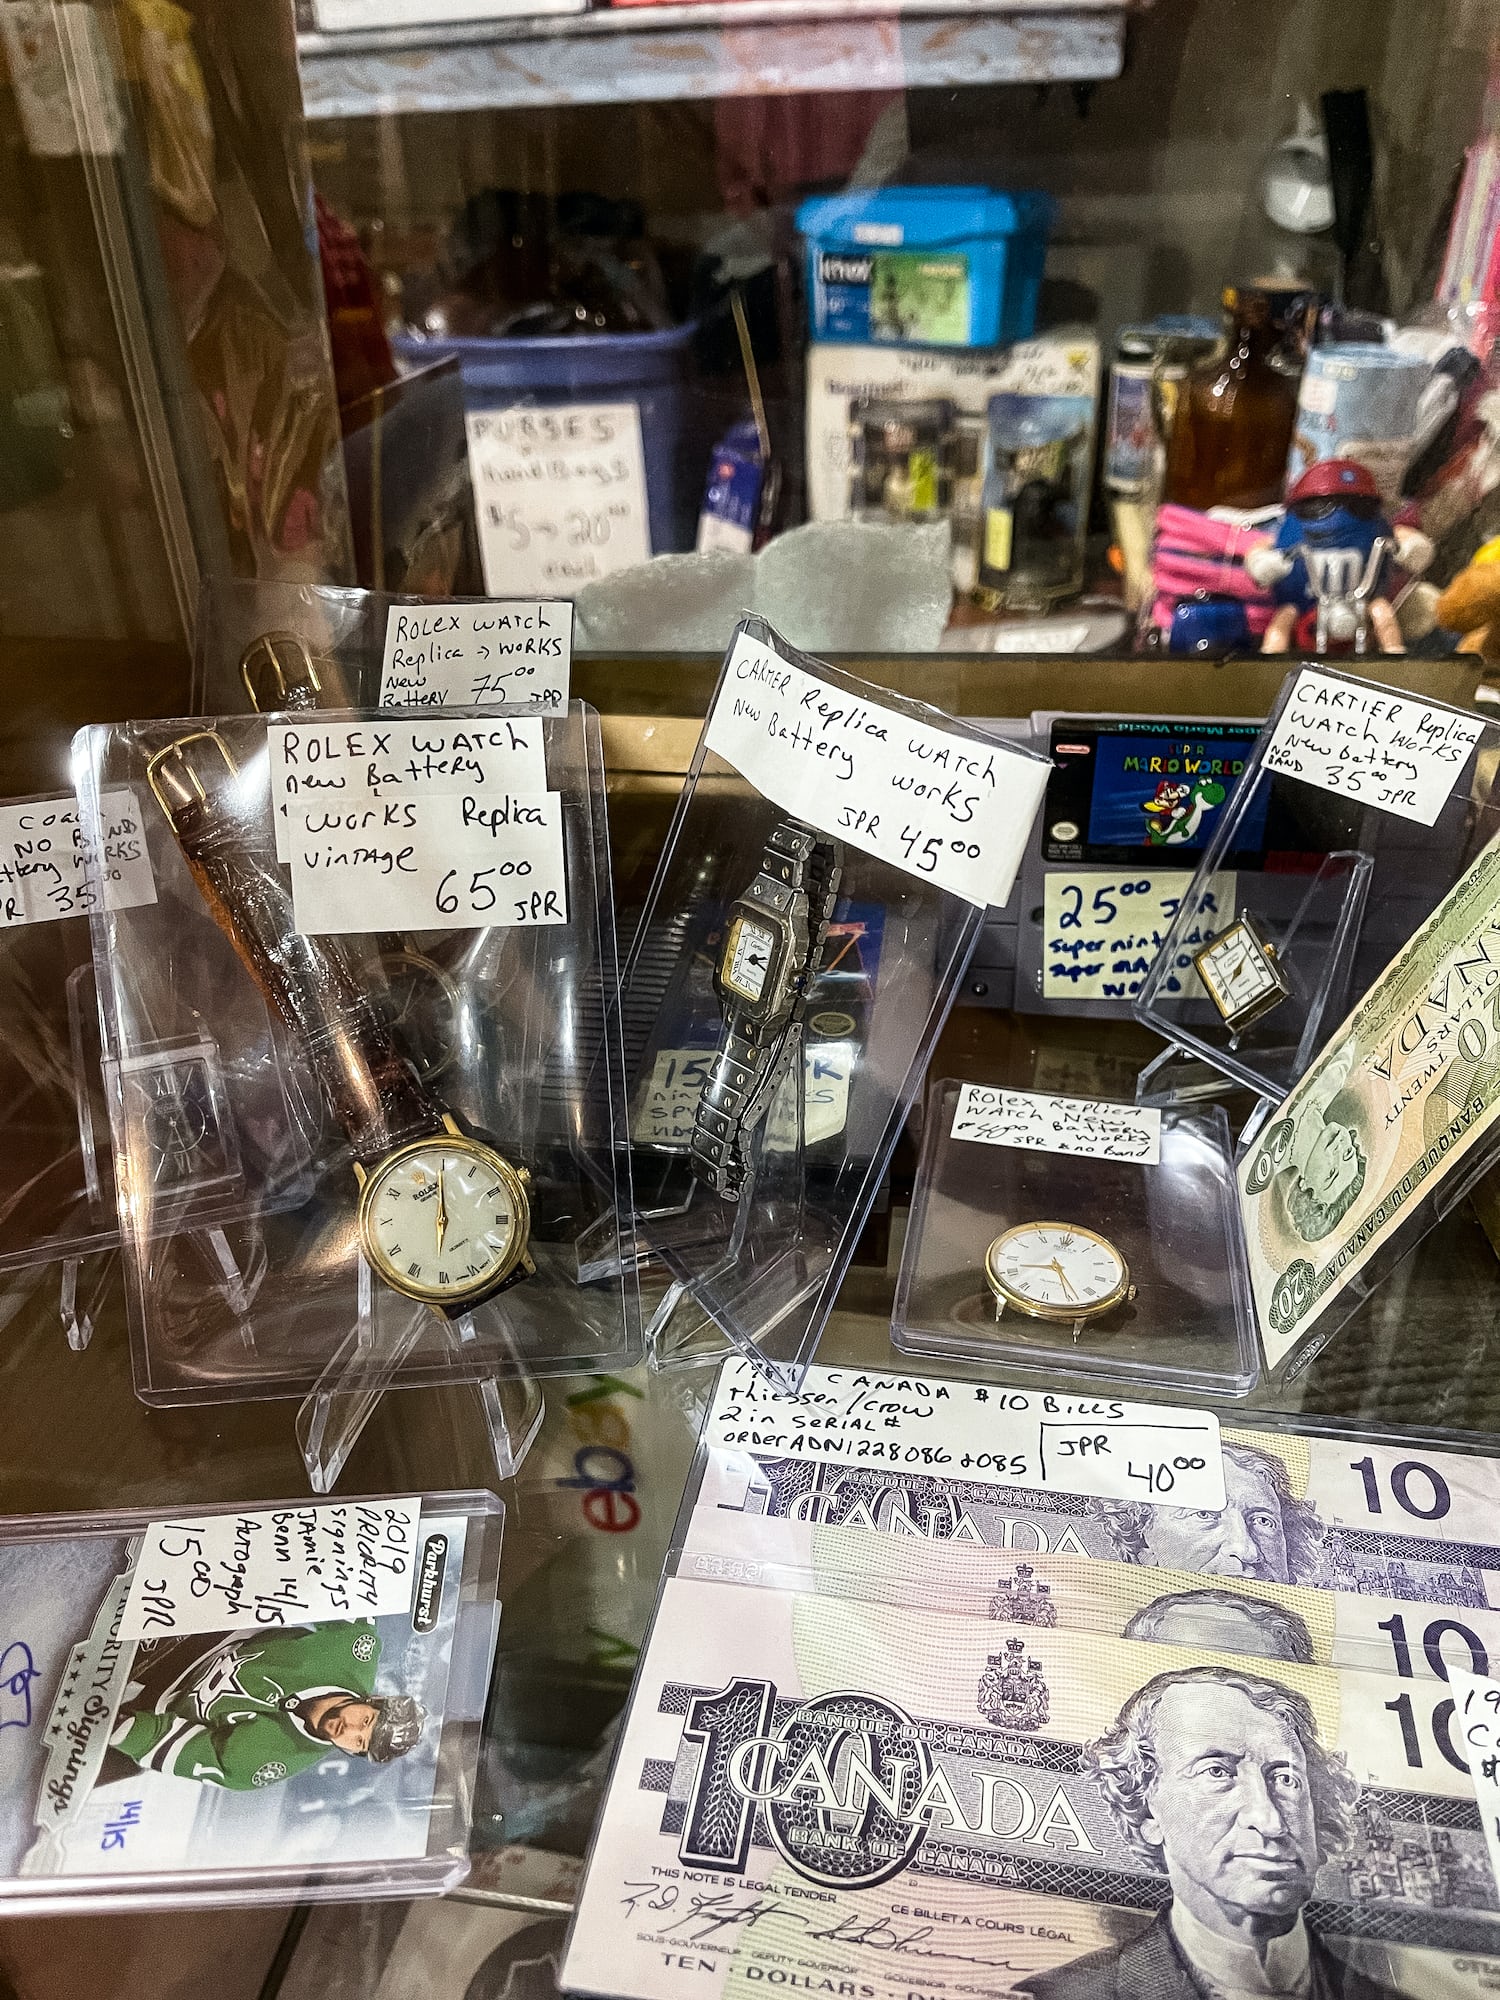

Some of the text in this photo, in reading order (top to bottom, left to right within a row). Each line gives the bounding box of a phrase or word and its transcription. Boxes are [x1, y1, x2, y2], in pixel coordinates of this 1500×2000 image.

[473, 415, 615, 442] PURSES
[392, 642, 464, 669] Replica
[800, 688, 888, 743] Replica
[1297, 684, 1403, 724] CARTIER
[283, 732, 392, 765] ROLEX
[733, 698, 762, 723] New
[769, 712, 855, 780] Battery
[1118, 724, 1170, 734] World
[1124, 757, 1245, 776] MARIO WORLD
[1268, 753, 1304, 773] BAND
[1270, 745, 1290, 758] NO
[1378, 789, 1417, 806] JPR
[462, 797, 547, 838] Replica
[837, 806, 881, 840] JPR
[14, 839, 51, 858] NO
[514, 891, 563, 921] JPR
[1160, 892, 1218, 918] JR
[1378, 1049, 1449, 1134] TWENTY
[1324, 1092, 1488, 1282] BANQUE DU CANADA
[1270, 1272, 1315, 1321] 20
[827, 1373, 950, 1399] CANADA
[719, 1406, 742, 1422] 2
[749, 1409, 775, 1425] in
[1057, 1434, 1112, 1456] JPR
[845, 1471, 1052, 1507] BANQUE DU CANADA
[1350, 1456, 1451, 1521] 10
[378, 1509, 410, 1575] 2019
[255, 1512, 309, 1625] Benn 14/15
[413, 1537, 446, 1625] Parkhurst
[141, 1579, 176, 1630] JPR
[1378, 1613, 1490, 1683] 10
[796, 1709, 1040, 1759] BANQUE DU CANADA
[48, 1694, 110, 1816] Signings
[728, 1738, 1103, 1856] CANADA
[101, 1800, 143, 1850] 14/15
[789, 1826, 1021, 1881] BANK OF CANADA
[650, 1865, 838, 1904] THIS NOTE IS LEGAL TENDER
[891, 1904, 910, 1915] CE
[913, 1907, 959, 1924] BILLET
[975, 1917, 1026, 1934] COURS
[661, 1952, 876, 1998] TEN DOLLARS
[751, 1951, 794, 1965] DEPUTY
